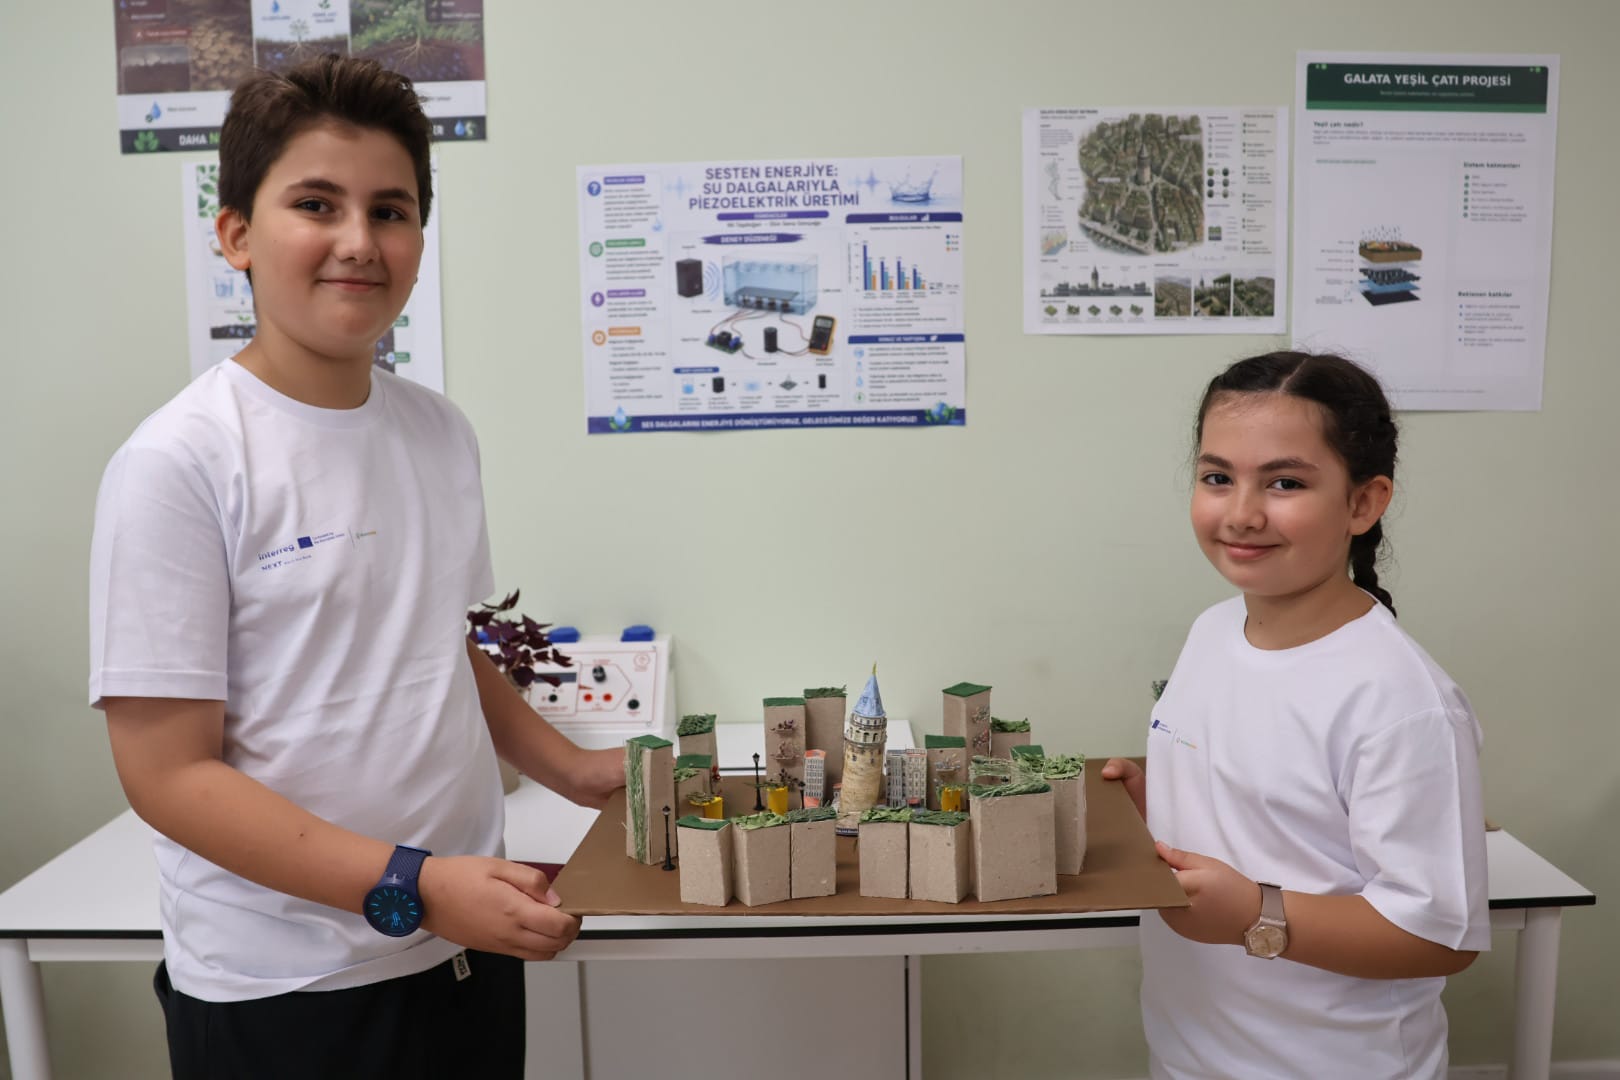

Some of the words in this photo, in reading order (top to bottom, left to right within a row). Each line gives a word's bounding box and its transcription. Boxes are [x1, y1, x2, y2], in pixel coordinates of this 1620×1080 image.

[1343, 73, 1391, 85] GALATA
[1394, 73, 1428, 87] YEŞİL
[1432, 74, 1459, 87] ÇATI
[1462, 74, 1512, 88] PROJESİ
[179, 134, 207, 146] DAHA
[705, 166, 761, 180] SESTEN
[764, 162, 838, 178] ENERJİYE:
[703, 181, 722, 195] SU
[726, 179, 839, 195] DALGALARIYLA
[689, 193, 798, 210] PİEZOELEKTRİK
[802, 190, 860, 207] ÜRETİMİ
